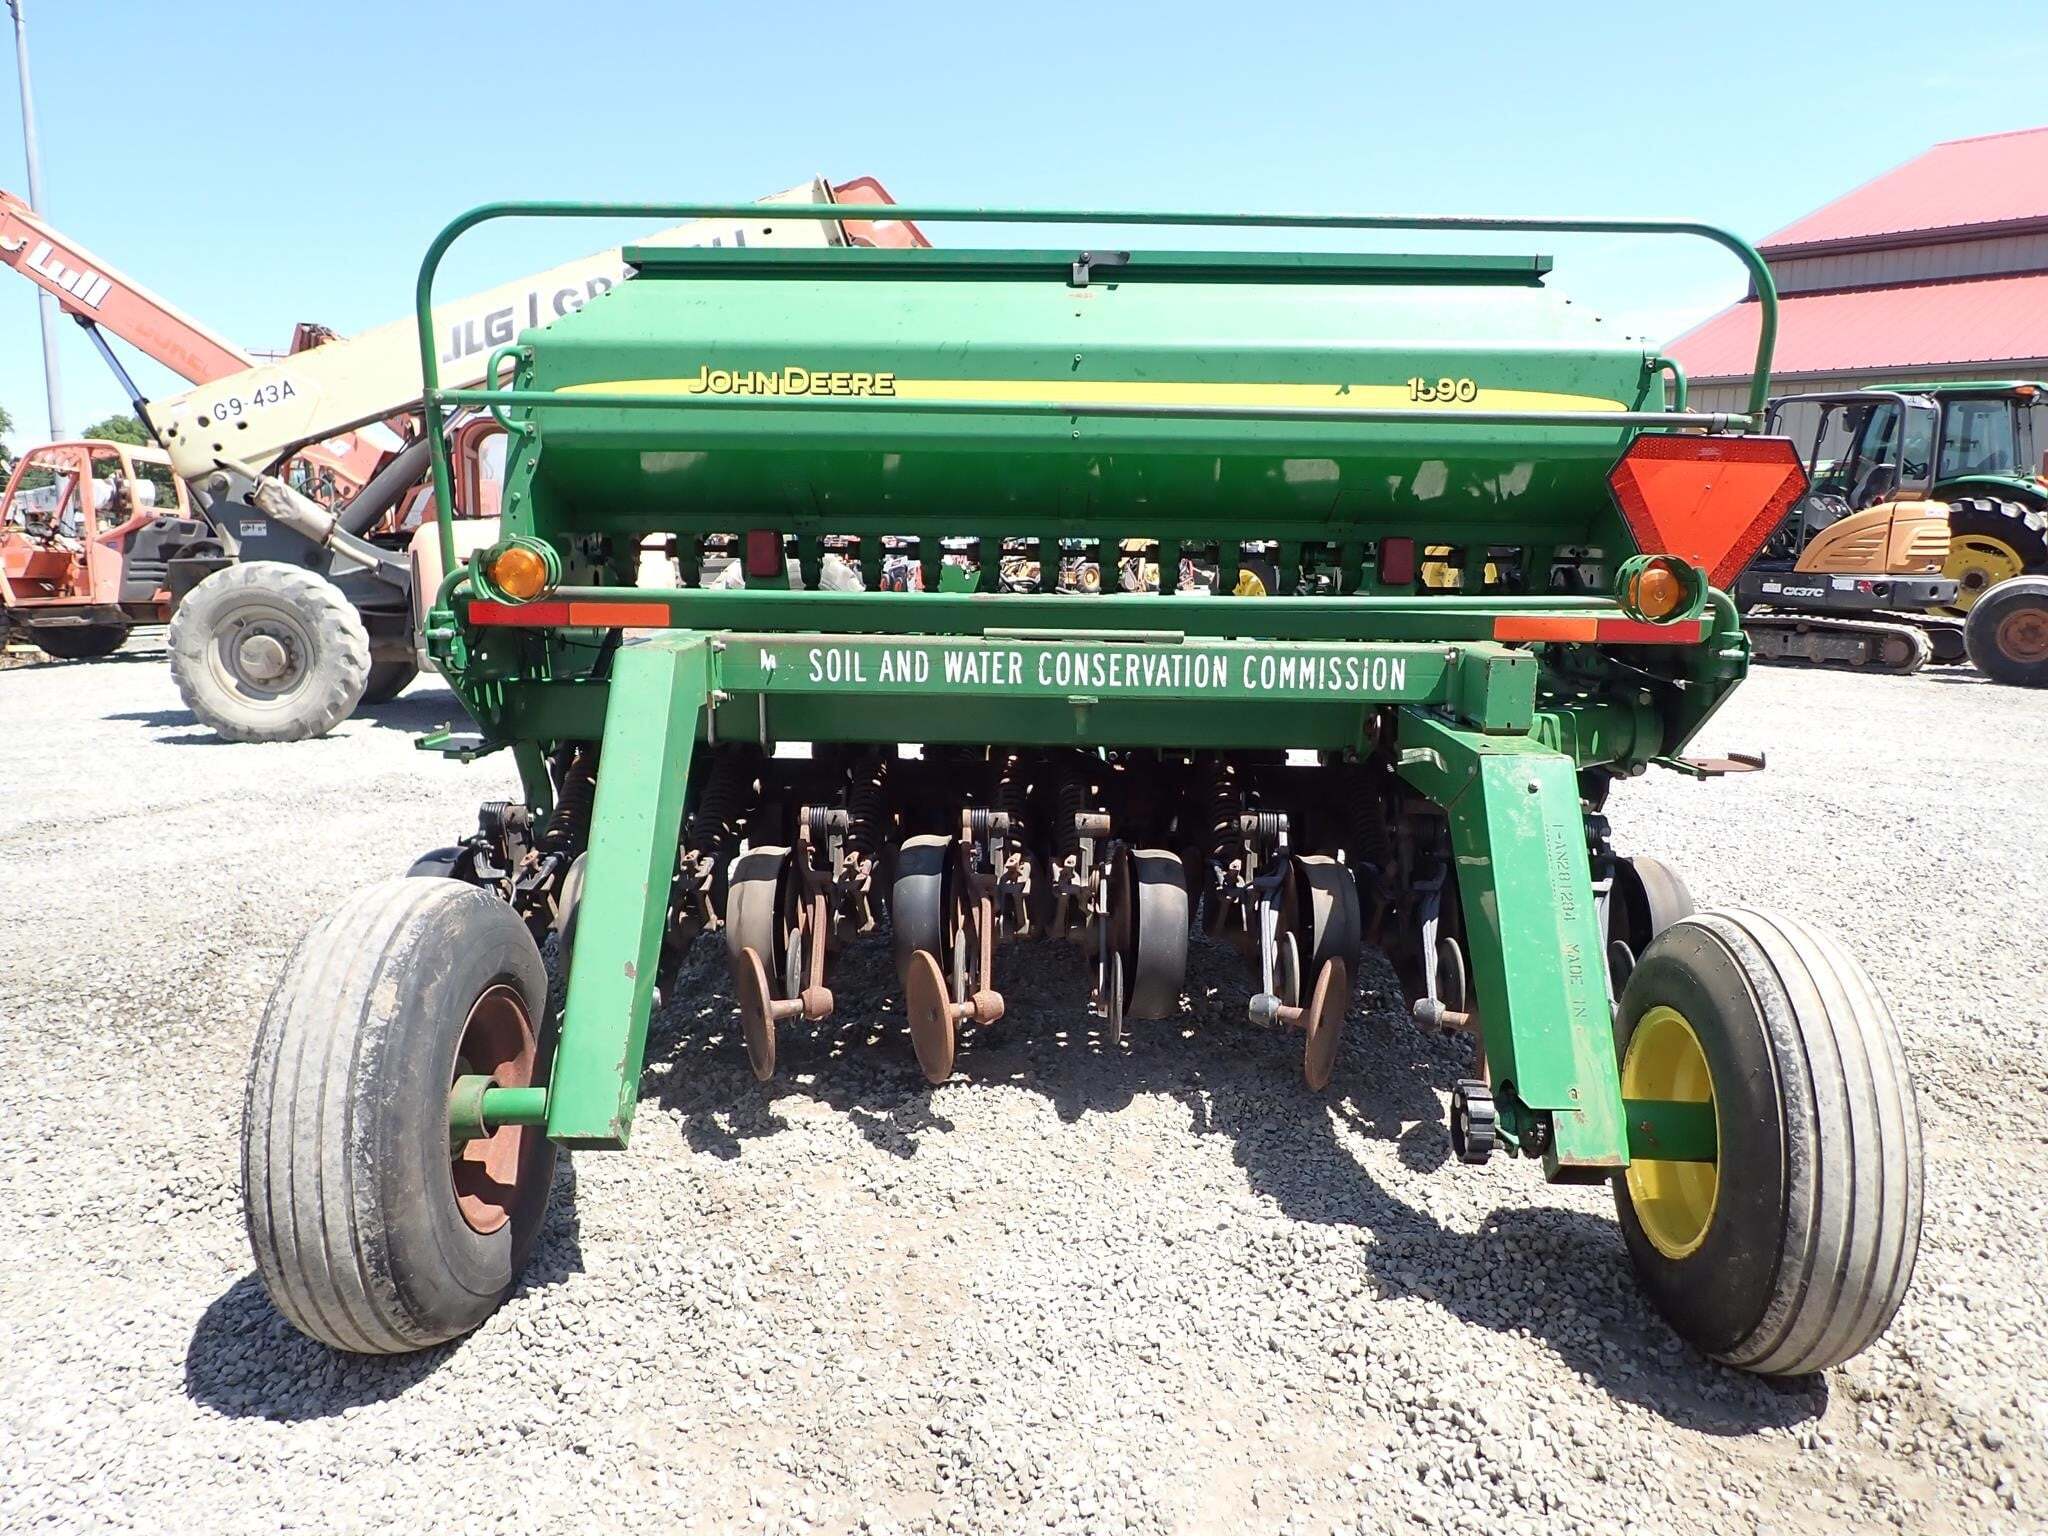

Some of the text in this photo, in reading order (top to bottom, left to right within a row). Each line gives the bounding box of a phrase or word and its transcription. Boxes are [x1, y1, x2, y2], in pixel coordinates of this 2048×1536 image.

[25, 238, 112, 310] Lull
[442, 306, 514, 364] JLG
[213, 380, 297, 421] G9-43A
[1407, 377, 1478, 403] 1590
[1782, 586, 1825, 598] CX37C
[808, 648, 867, 683] SOIL
[878, 650, 930, 684] AND
[944, 651, 1023, 685] WATER
[1038, 651, 1228, 689] CONSERVATION
[1243, 655, 1406, 691] COMMISSION
